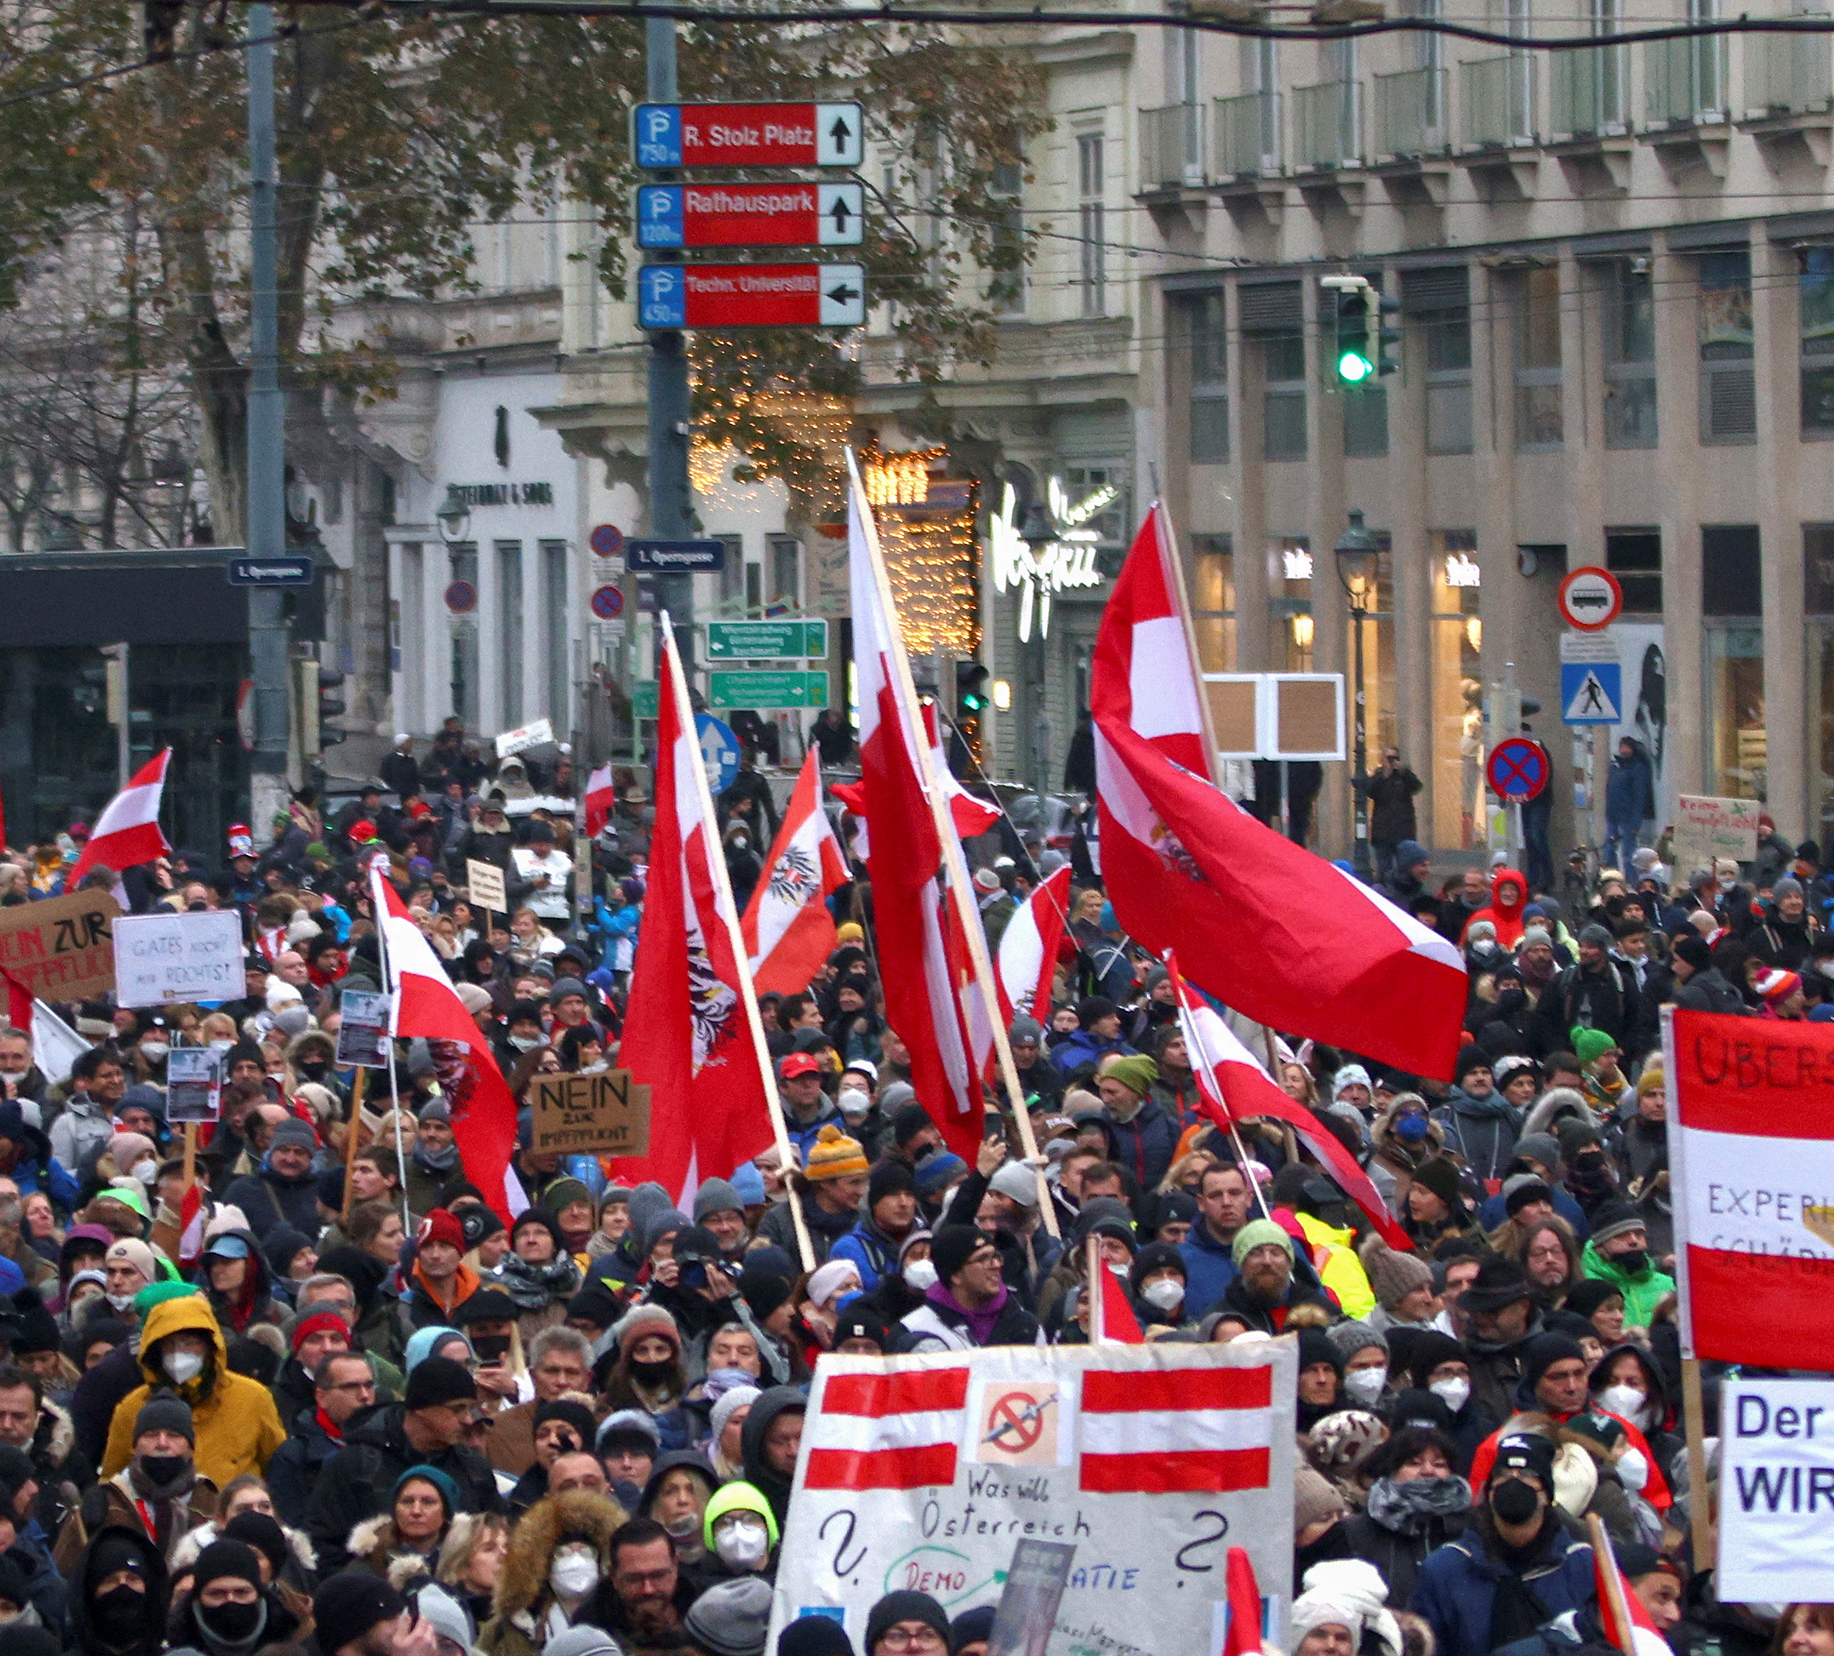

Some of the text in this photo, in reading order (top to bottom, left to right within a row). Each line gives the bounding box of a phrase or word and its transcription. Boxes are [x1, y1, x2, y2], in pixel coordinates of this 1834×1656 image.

[684, 125, 814, 147] R. Stolz Platz
[686, 191, 815, 215] Rathauspark
[53, 911, 113, 953] ZUR
[540, 1075, 629, 1111] NEIN
[1735, 1394, 1824, 1439] Der
[967, 1468, 1051, 1503] Was will
[919, 1486, 1093, 1539] Österreich
[904, 1563, 966, 1593] DEMO
